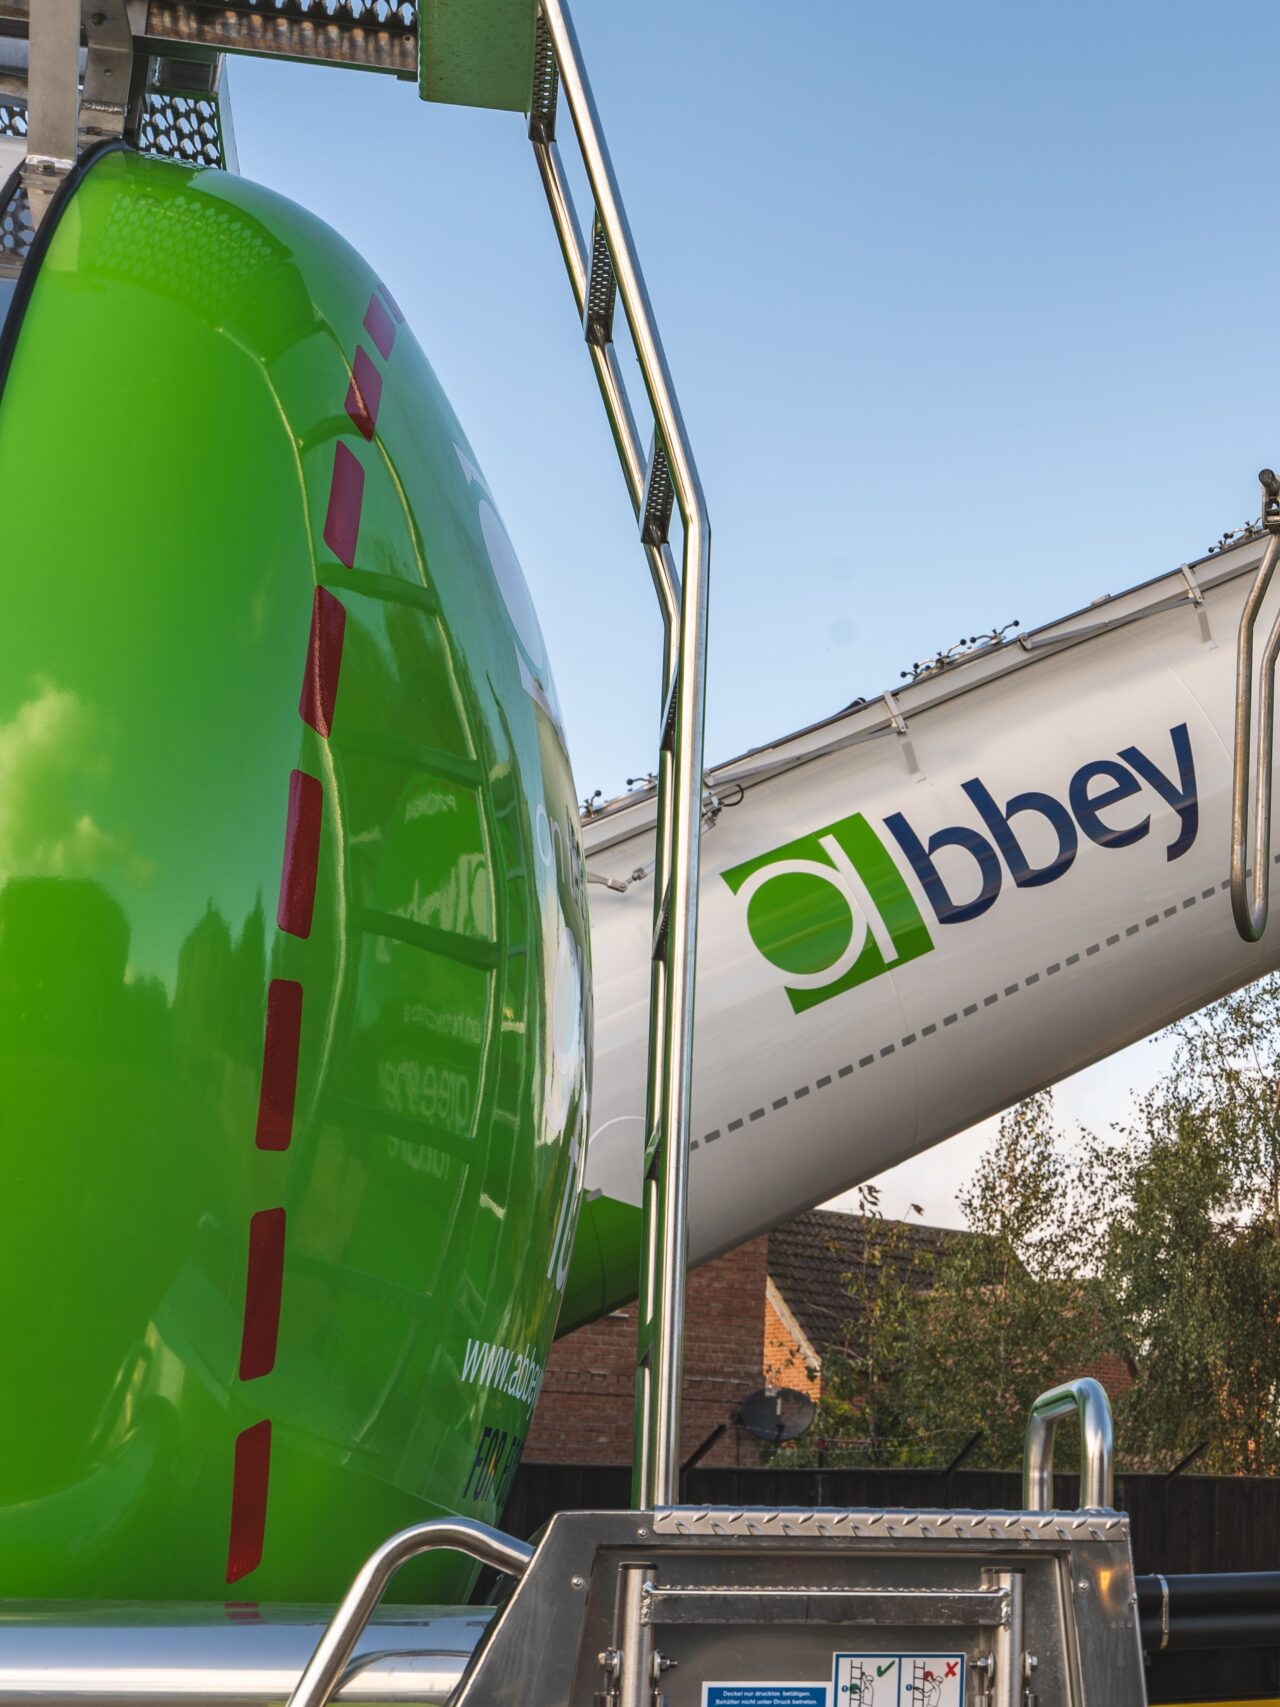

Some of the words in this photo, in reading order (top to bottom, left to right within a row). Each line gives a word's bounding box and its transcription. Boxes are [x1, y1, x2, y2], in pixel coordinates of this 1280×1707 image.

[719, 722, 1199, 1015] abbey
[722, 1690, 743, 1698] Deckel
[741, 1698, 756, 1706] nicht
[757, 1698, 773, 1706] unter
[773, 1698, 791, 1706] Druck
